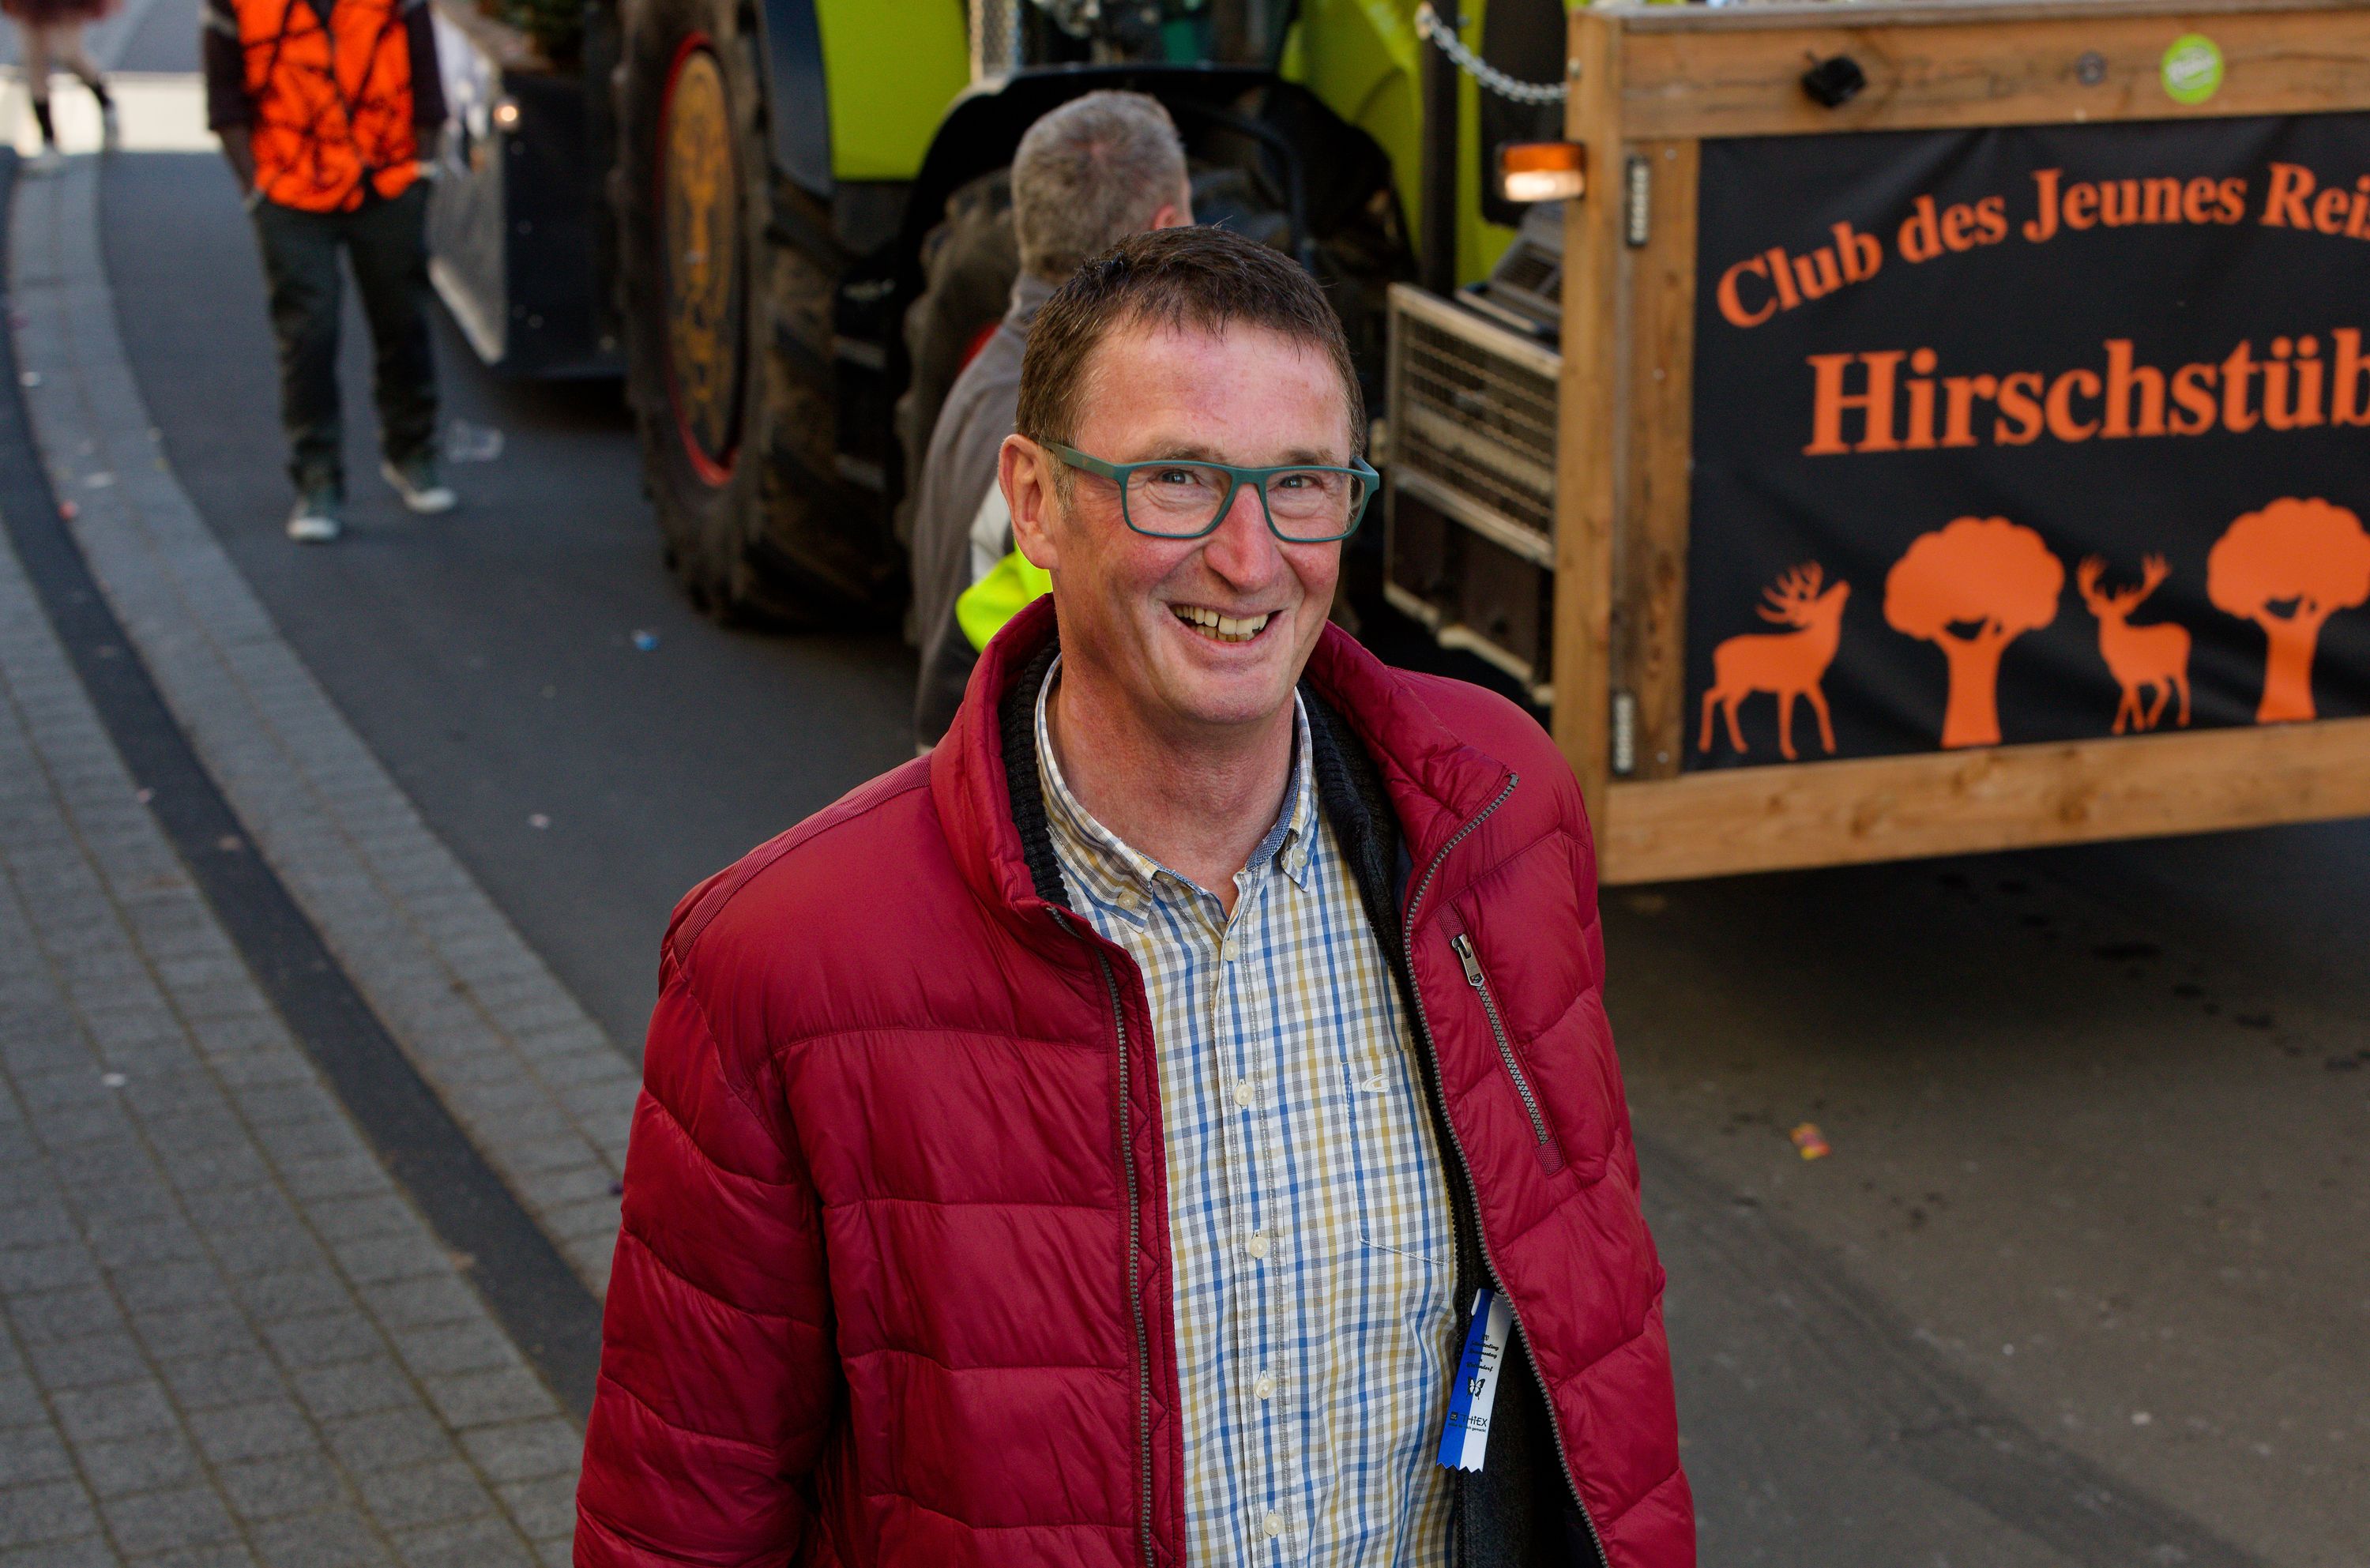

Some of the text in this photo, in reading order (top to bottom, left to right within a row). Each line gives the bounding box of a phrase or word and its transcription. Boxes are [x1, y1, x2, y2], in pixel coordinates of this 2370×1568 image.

[1717, 163, 2370, 327] Club des Jeunes Rei
[1804, 328, 2370, 456] Hirschstüb
